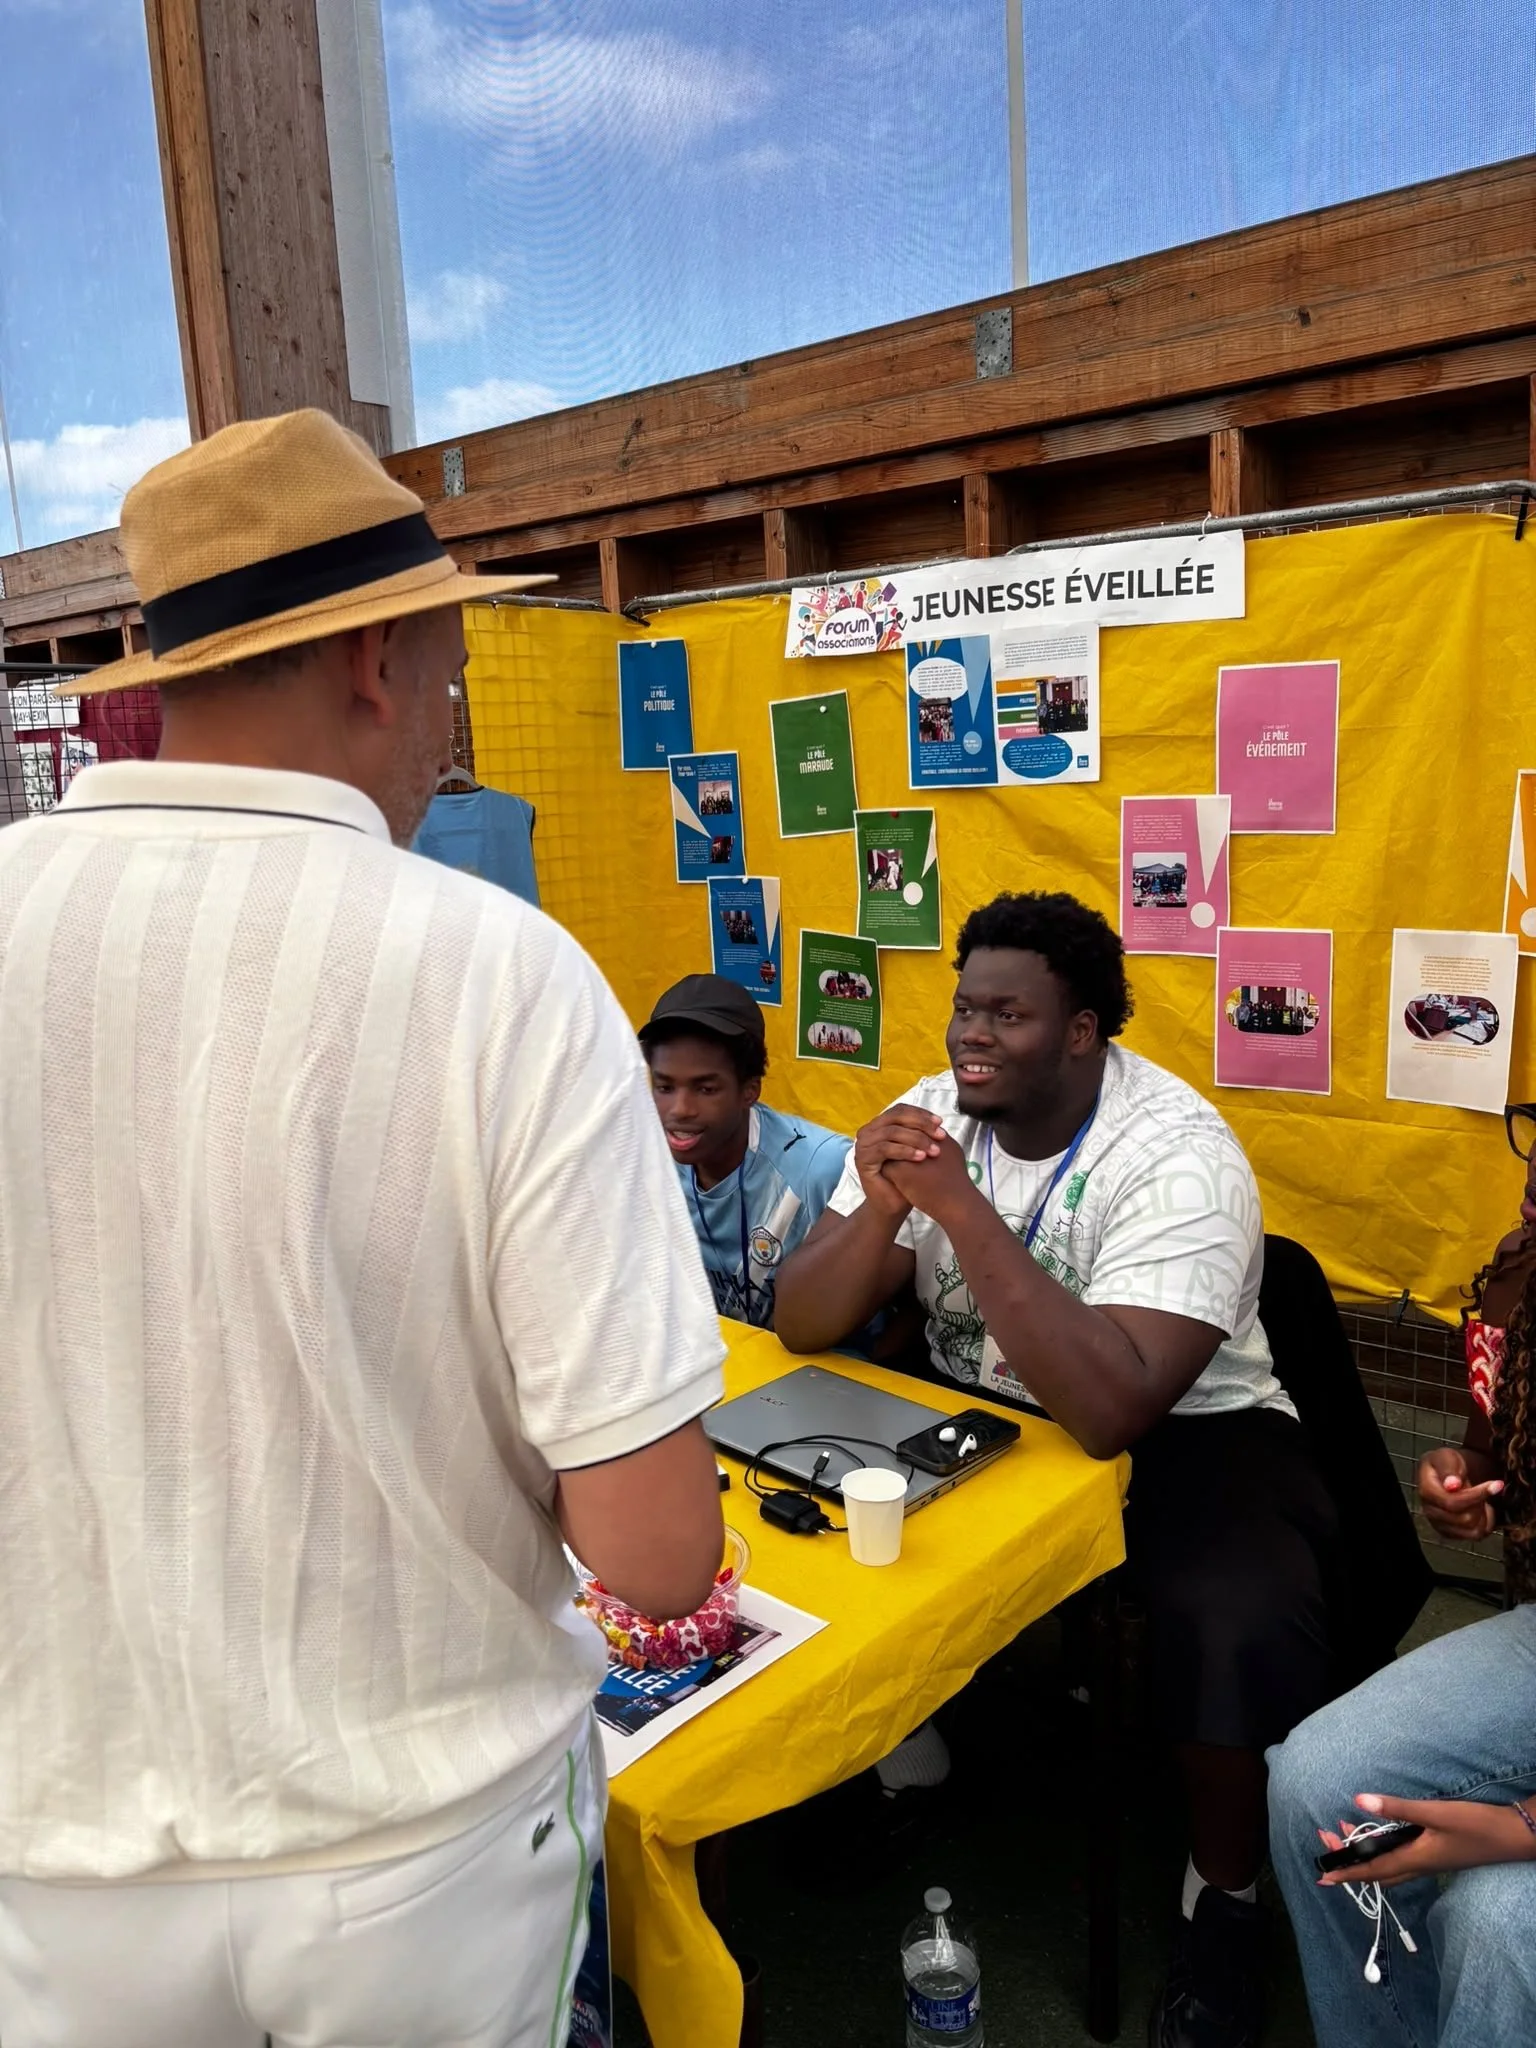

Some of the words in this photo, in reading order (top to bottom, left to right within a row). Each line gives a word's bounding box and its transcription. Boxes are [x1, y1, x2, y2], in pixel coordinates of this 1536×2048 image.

[911, 578, 1055, 622] JEUNESSE
[1065, 558, 1215, 605] ÉVEILLÉE
[643, 699, 675, 712] POLITIQUE
[1263, 731, 1271, 741] LE
[1272, 729, 1289, 741] PÔLE
[807, 751, 814, 760] LE
[1246, 740, 1307, 758] ÉVÉNEMENT
[799, 758, 834, 774] MARAUDE
[990, 1375, 999, 1383] LA
